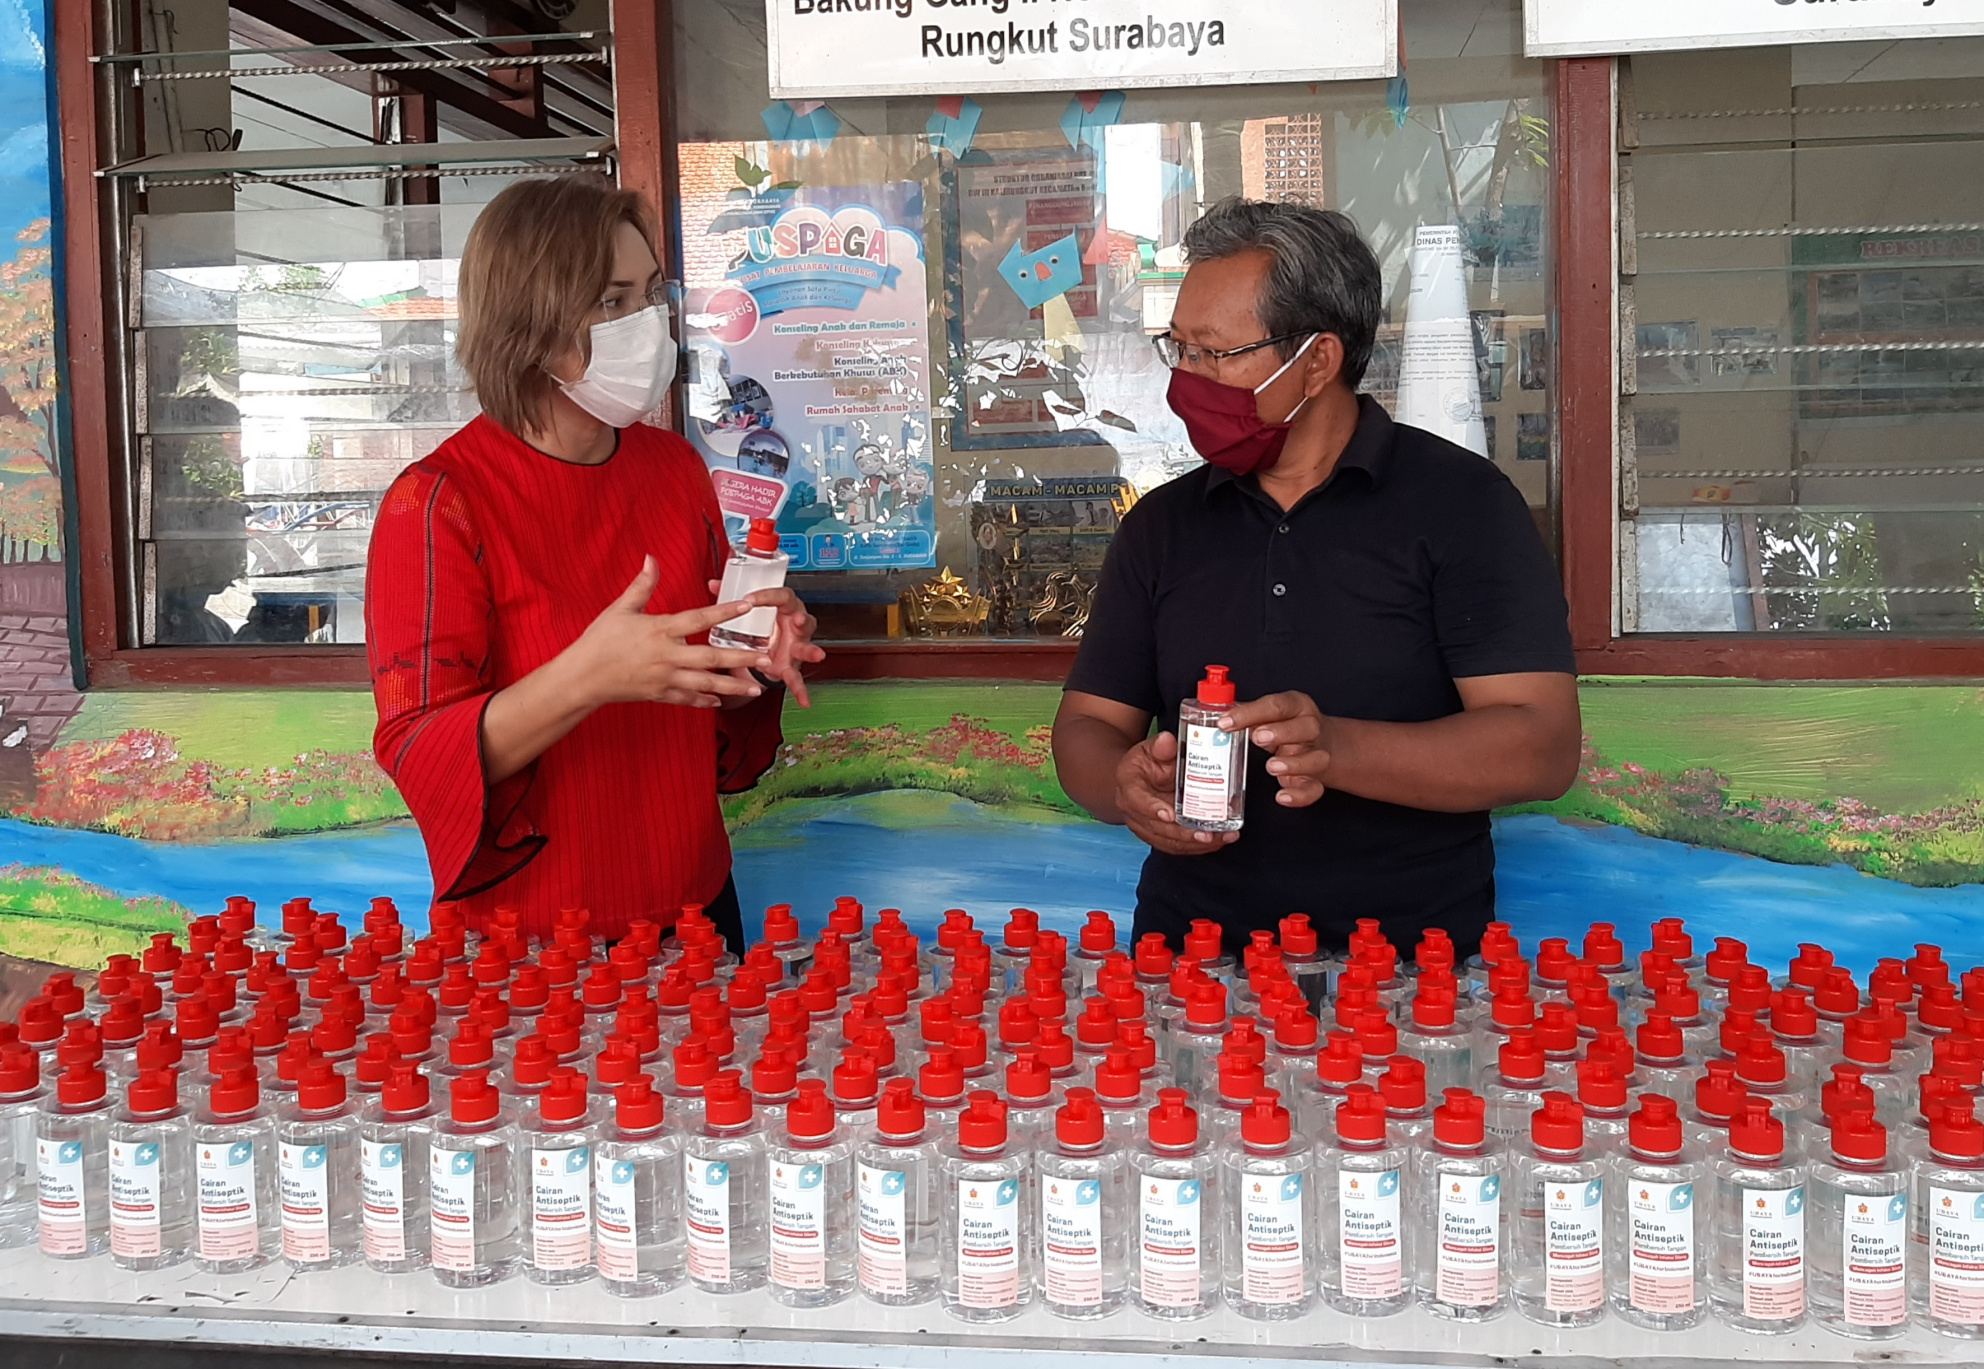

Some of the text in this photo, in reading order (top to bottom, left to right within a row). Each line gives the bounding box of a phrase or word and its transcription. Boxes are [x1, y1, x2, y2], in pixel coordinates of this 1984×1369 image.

[921, 15, 1225, 65] Rungkut Surabaya
[1416, 238, 1443, 246] DINAS
[765, 264, 830, 276] PEMBELAJARAN
[835, 265, 878, 279] KELUARGA
[774, 321, 905, 333] Konseling Anak dan Remaja
[816, 340, 861, 350] Konseling
[775, 371, 841, 380] Berkebutuhan
[844, 370, 876, 378] Khusus
[806, 403, 908, 415] Rumah Sahabat Anak
[990, 486, 1043, 496] MACAM
[1055, 484, 1107, 495] MACAM
[201, 1178, 226, 1187] Cairan
[201, 1187, 245, 1198] Antiseptik
[536, 1186, 563, 1195] Cairan
[536, 1195, 581, 1205] Antiseptik
[773, 1196, 796, 1209] Cairan
[773, 1208, 813, 1221] Antiseptik
[1047, 1213, 1073, 1226] Cairan
[1145, 1213, 1173, 1226] Cairan
[1248, 1213, 1277, 1223] Cairan
[1344, 1209, 1374, 1219] Cairan
[1444, 1212, 1475, 1224] Cairan
[963, 1219, 992, 1228] Cairan
[1248, 1224, 1295, 1235] Antiseptik
[1345, 1220, 1392, 1231] Antiseptik
[1550, 1221, 1581, 1230] Cairan
[1634, 1219, 1666, 1231] Cairan
[963, 1229, 1009, 1239] Antiseptik
[1047, 1224, 1091, 1238] Antiseptik
[1145, 1225, 1191, 1238] Antiseptik
[1444, 1224, 1492, 1236] Antiseptik
[1550, 1230, 1597, 1242] Antiseptik
[1750, 1229, 1782, 1238] Cairan
[1935, 1227, 1970, 1240] Cairan
[1634, 1230, 1685, 1244] Antiseptik
[1851, 1234, 1884, 1244] Cairan
[1750, 1239, 1798, 1251] Antiseptik
[1851, 1245, 1900, 1256] Antiseptik
[1936, 1238, 1984, 1254] Antisepti
[1970, 1254, 1984, 1263] Tang
